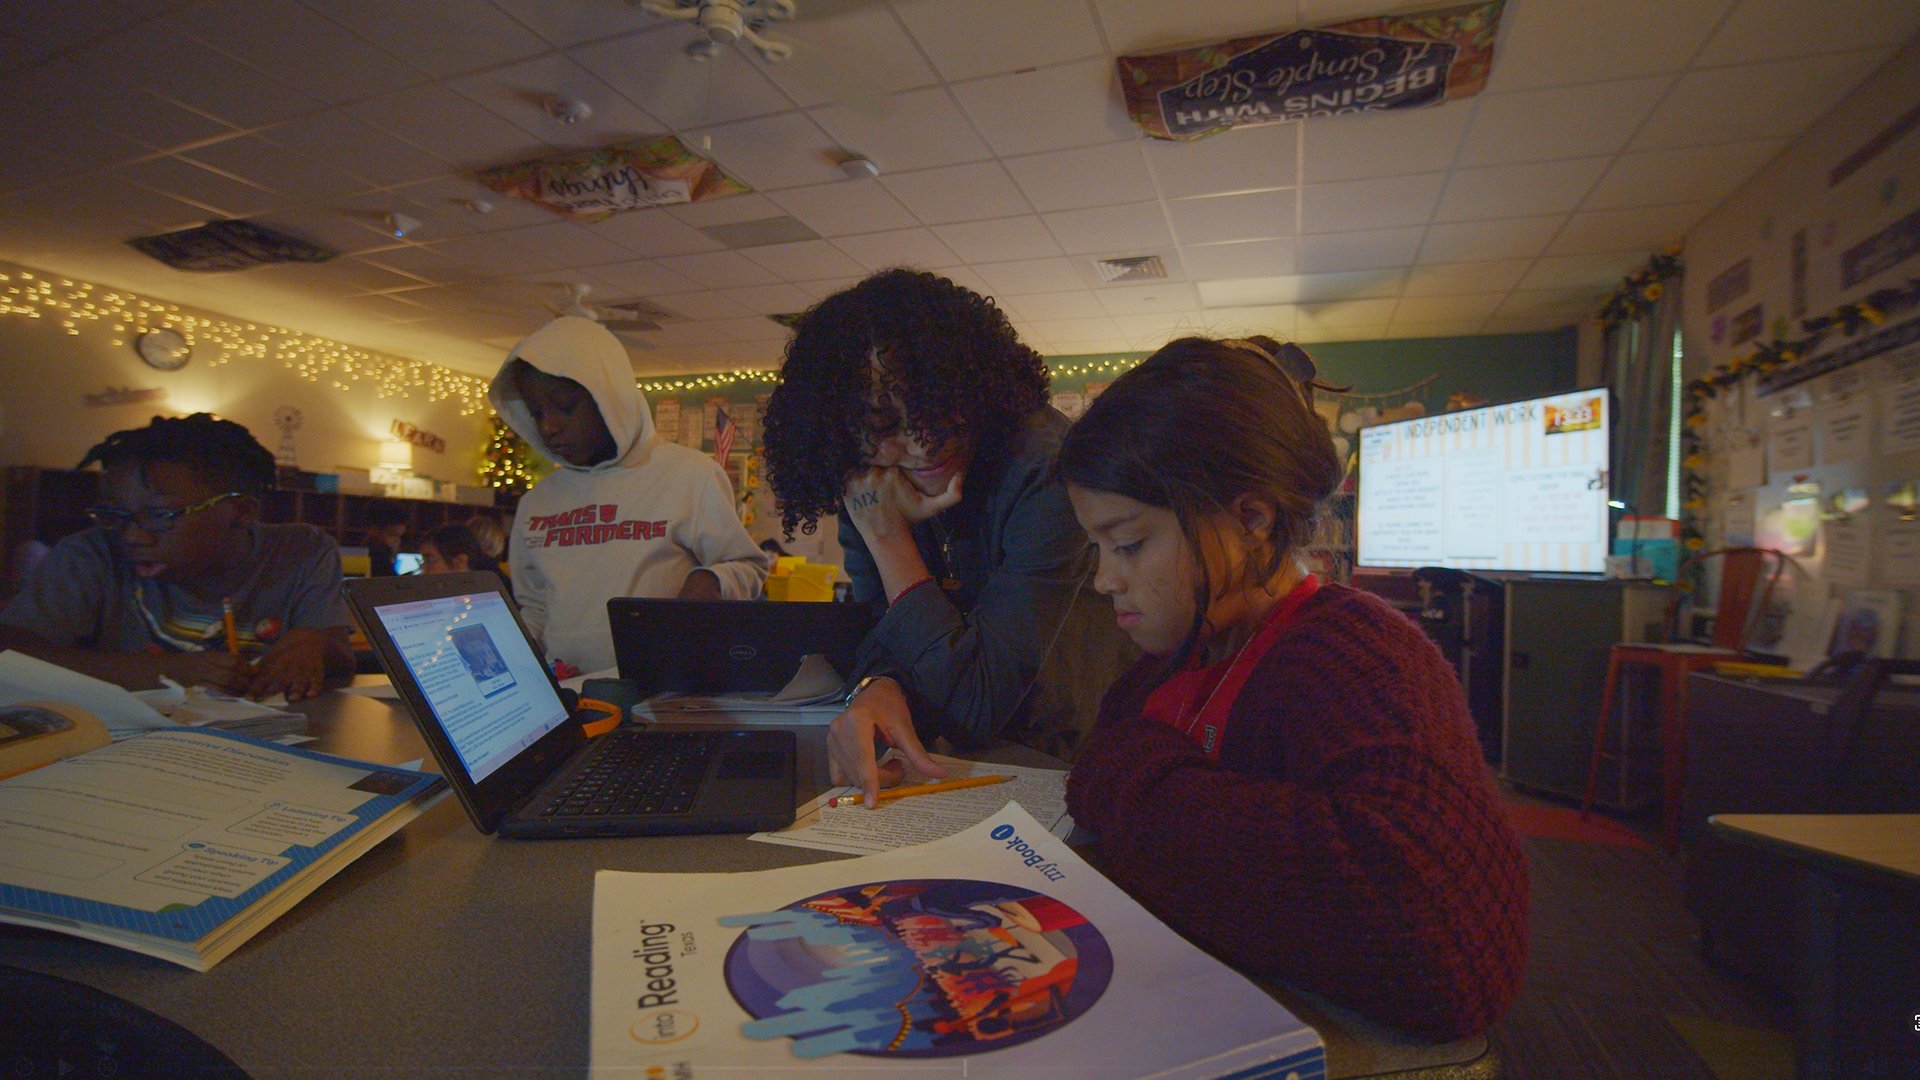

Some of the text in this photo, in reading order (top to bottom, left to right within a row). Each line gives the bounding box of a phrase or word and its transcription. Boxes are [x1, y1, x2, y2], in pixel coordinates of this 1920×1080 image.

[1185, 41, 1431, 102] A Simple Step
[1284, 66, 1436, 111] BEGINS
[1176, 101, 1272, 125] WITH
[549, 166, 648, 199] things
[1404, 404, 1538, 439] INDEPENDENT WORK
[529, 504, 597, 531] TRANS
[544, 520, 668, 547] FORMERS
[223, 746, 289, 767] Discussion
[204, 847, 279, 866] Speaking Tip
[1006, 836, 1066, 882] myBook
[681, 931, 697, 958] Texas
[633, 922, 678, 1009] Reading
